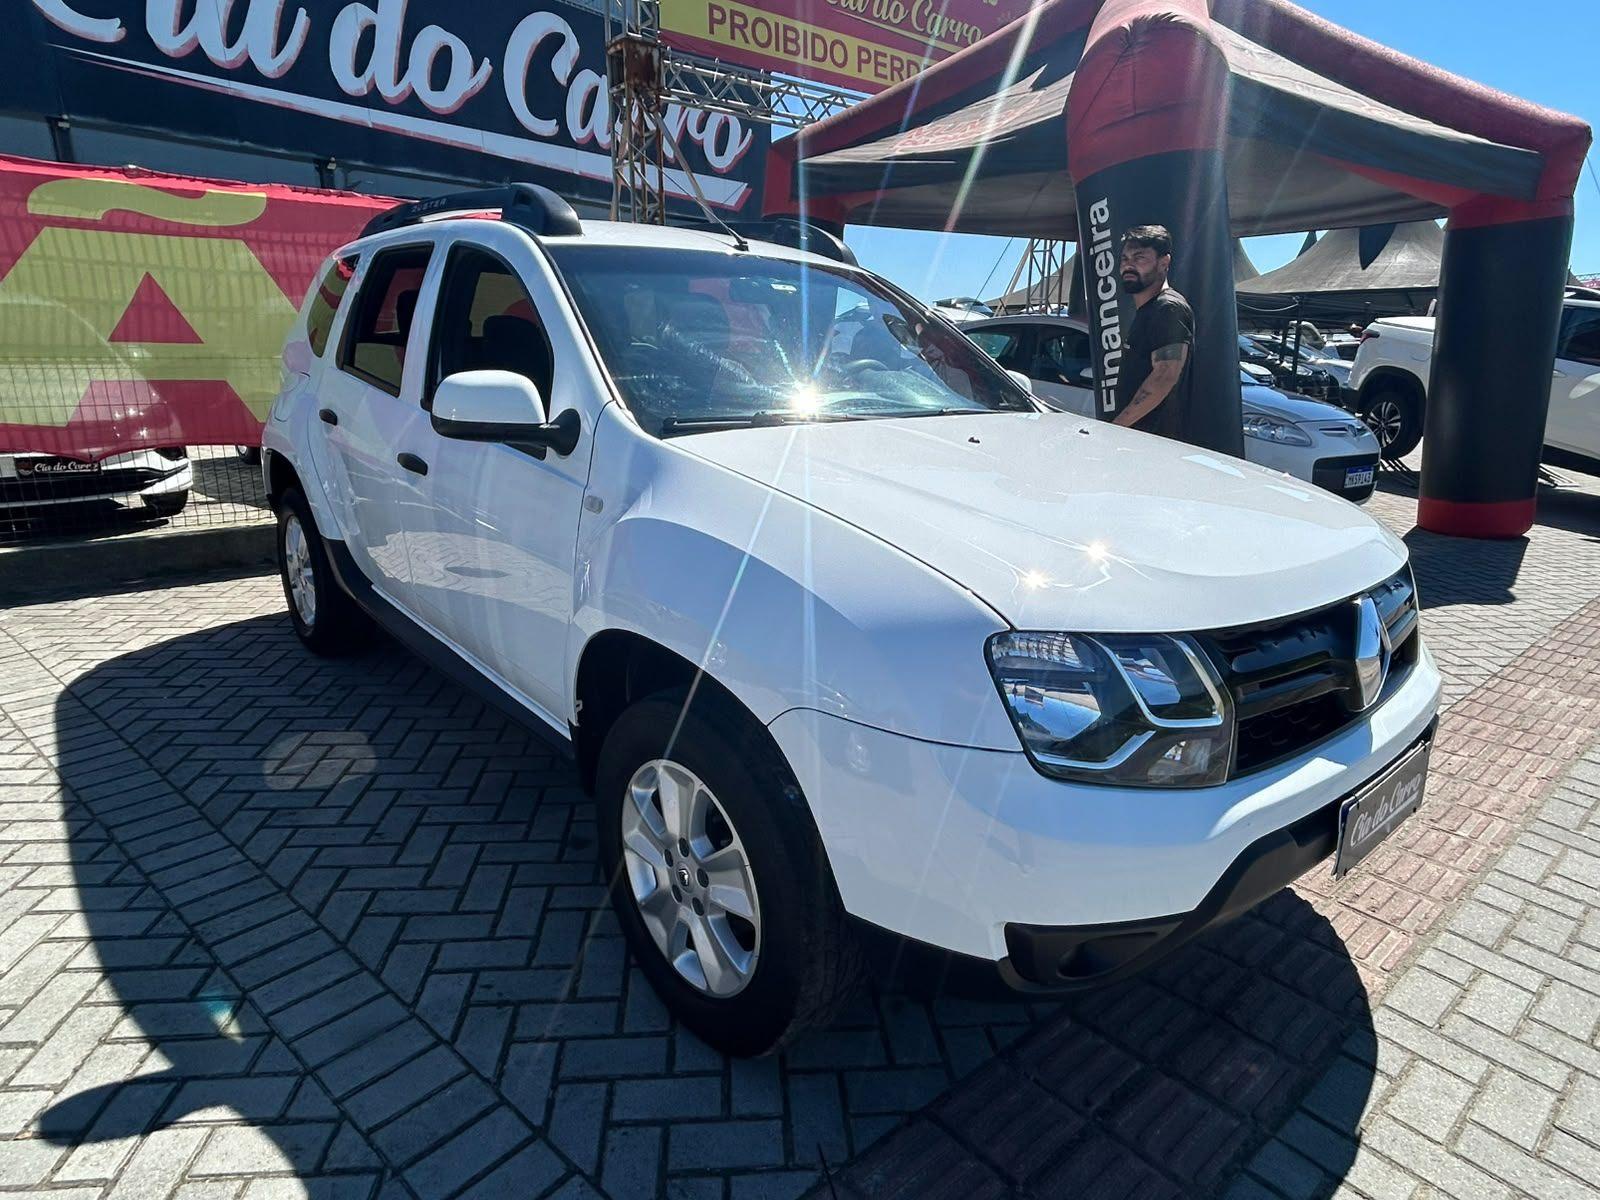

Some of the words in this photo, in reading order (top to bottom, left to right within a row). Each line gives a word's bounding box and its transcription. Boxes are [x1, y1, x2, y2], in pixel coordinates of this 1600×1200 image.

[329, 0, 493, 114] do
[708, 3, 849, 69] PROIBIDO
[857, 45, 931, 82] PERD
[911, 0, 984, 46] Carro
[1089, 197, 1122, 413] Financeira
[53, 462, 66, 471] do
[1350, 812, 1371, 846] Cia
[1371, 795, 1388, 829] do
[1389, 774, 1422, 813] Carro
